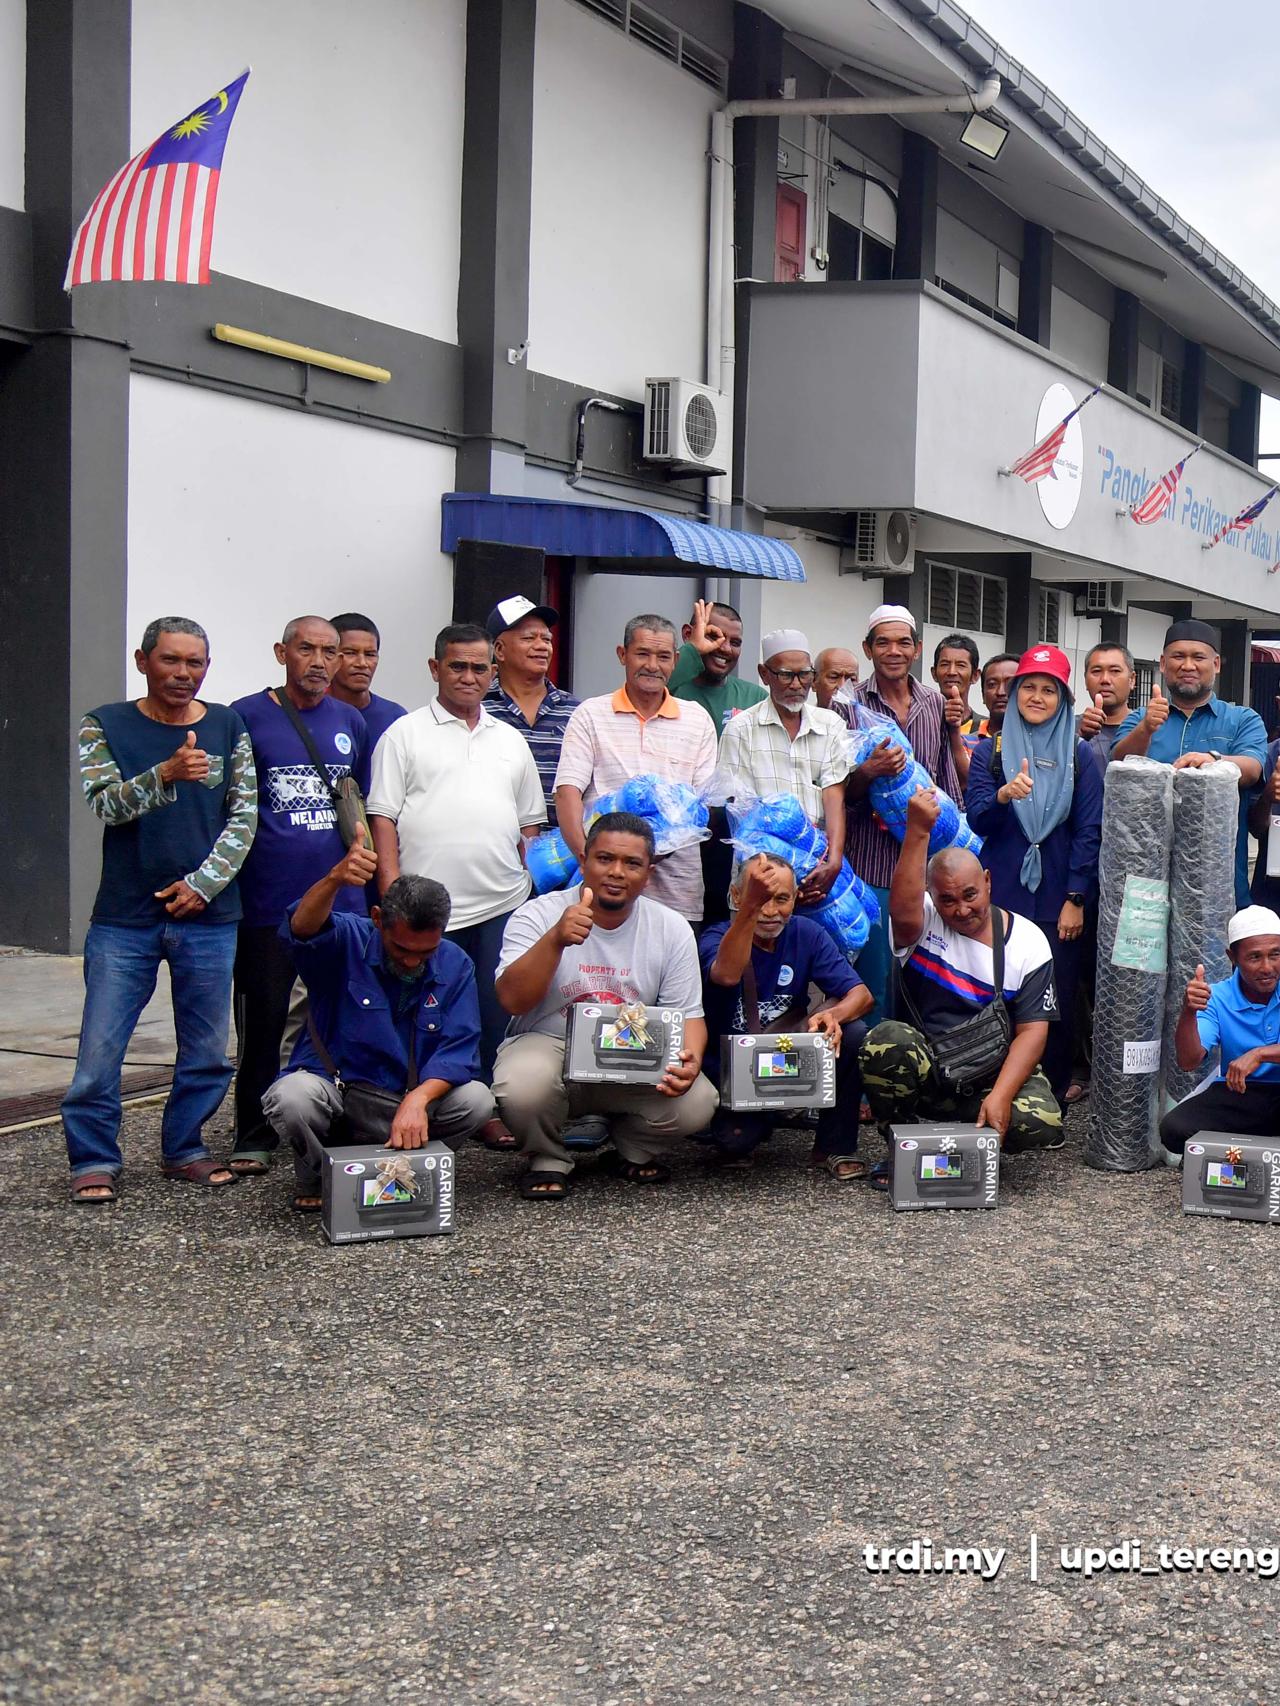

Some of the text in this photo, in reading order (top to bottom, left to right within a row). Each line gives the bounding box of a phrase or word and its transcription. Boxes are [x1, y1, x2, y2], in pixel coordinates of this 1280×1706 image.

[669, 1011, 683, 1066] GARMI
[439, 1156, 452, 1227] GARMIN
[985, 1138, 998, 1202] GARMIN
